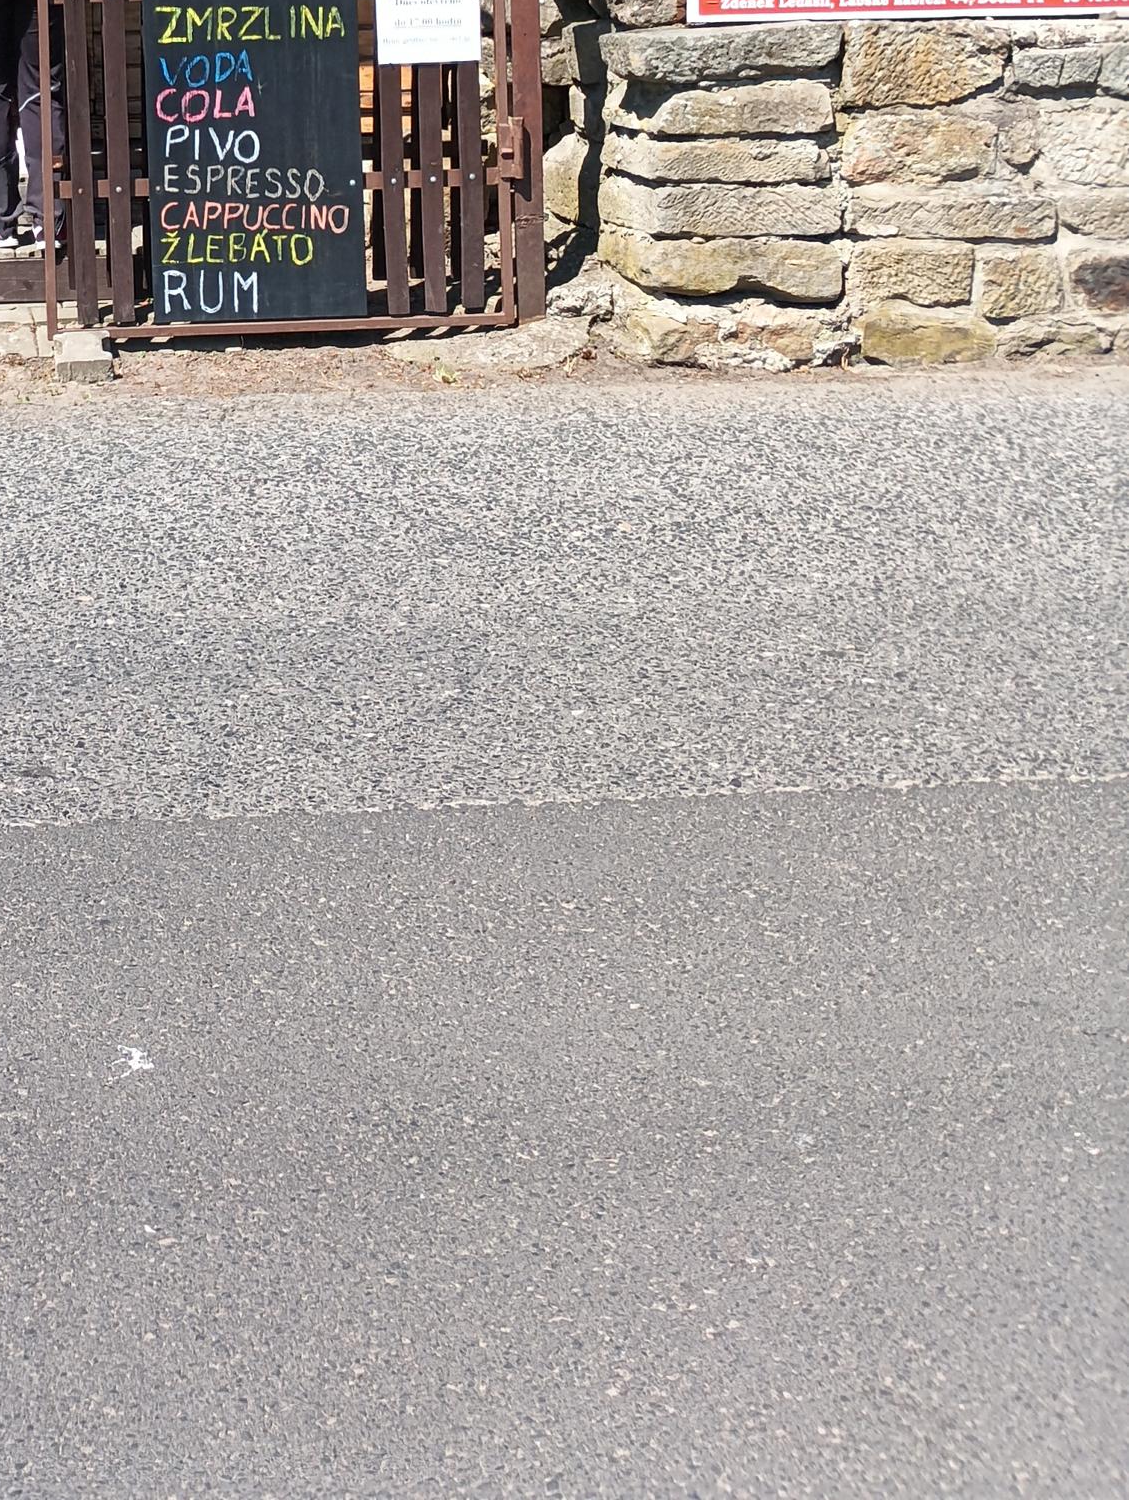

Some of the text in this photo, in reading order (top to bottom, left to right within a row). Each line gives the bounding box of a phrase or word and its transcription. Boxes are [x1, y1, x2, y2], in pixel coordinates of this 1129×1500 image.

[155, 5, 345, 43] ZMRZLINA
[159, 49, 253, 88] VODA
[155, 85, 256, 122] COLA
[165, 124, 260, 164] PIVO
[163, 164, 328, 201] ESPRESSO
[161, 201, 350, 234] CAPPUCCINO
[163, 269, 259, 314] RUM
